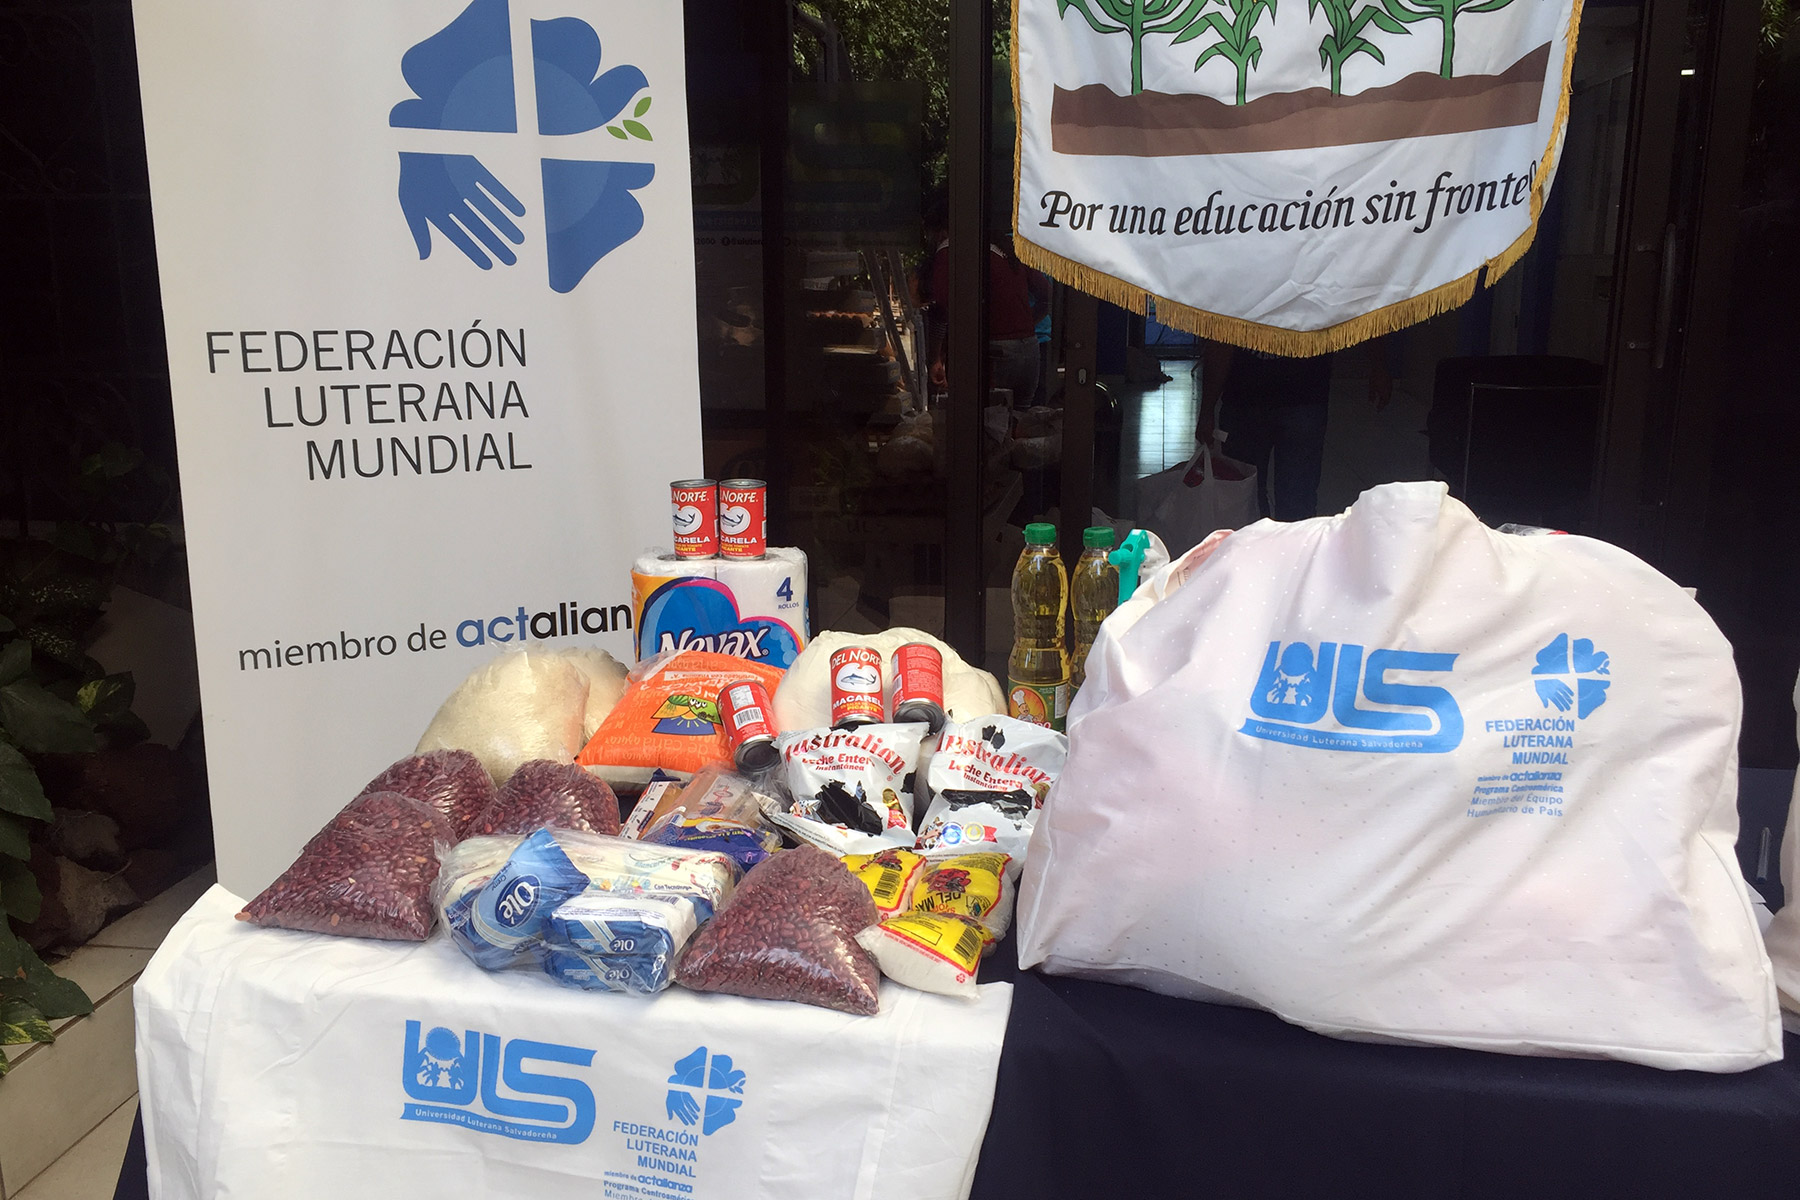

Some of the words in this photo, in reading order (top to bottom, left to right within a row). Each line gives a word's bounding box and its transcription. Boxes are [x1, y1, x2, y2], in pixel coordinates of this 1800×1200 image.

[1039, 190, 1108, 231] Por
[1110, 201, 1167, 236] una
[1173, 186, 1355, 236] educación
[1361, 180, 1418, 225] sin
[206, 319, 528, 374] FEDERACIÓN
[264, 380, 530, 429] LUTERANA
[306, 431, 533, 481] MUNDIAL
[673, 490, 707, 503] NORTE
[721, 490, 757, 503] NORTE
[776, 576, 794, 602] 4
[238, 631, 398, 671] miembro
[406, 623, 448, 652] de
[455, 602, 633, 649] actalian
[831, 653, 846, 669] DEL
[1485, 715, 1575, 733] FEDERACIÓN
[1255, 725, 1309, 742] Universidad
[1312, 735, 1358, 747] Luterana
[1503, 735, 1574, 748] LUTERANA
[1512, 752, 1569, 765] MUNDIAL
[1510, 770, 1562, 782] actalianza
[1474, 785, 1510, 796] Programa
[1521, 806, 1535, 814] de
[498, 881, 535, 925] Olé
[612, 938, 635, 953] Olé
[606, 968, 630, 980] Olé
[415, 1107, 466, 1123] Universidad
[467, 1116, 503, 1132] Luterana
[504, 1125, 558, 1140] Salvadoreña
[613, 1120, 699, 1147] FEDERACIÓN
[627, 1138, 697, 1162] LUTERANA
[637, 1155, 697, 1178] MUNDIAL
[603, 1180, 640, 1193] Programa
[604, 1170, 629, 1179] miembro
[637, 1174, 693, 1193] actalianza
